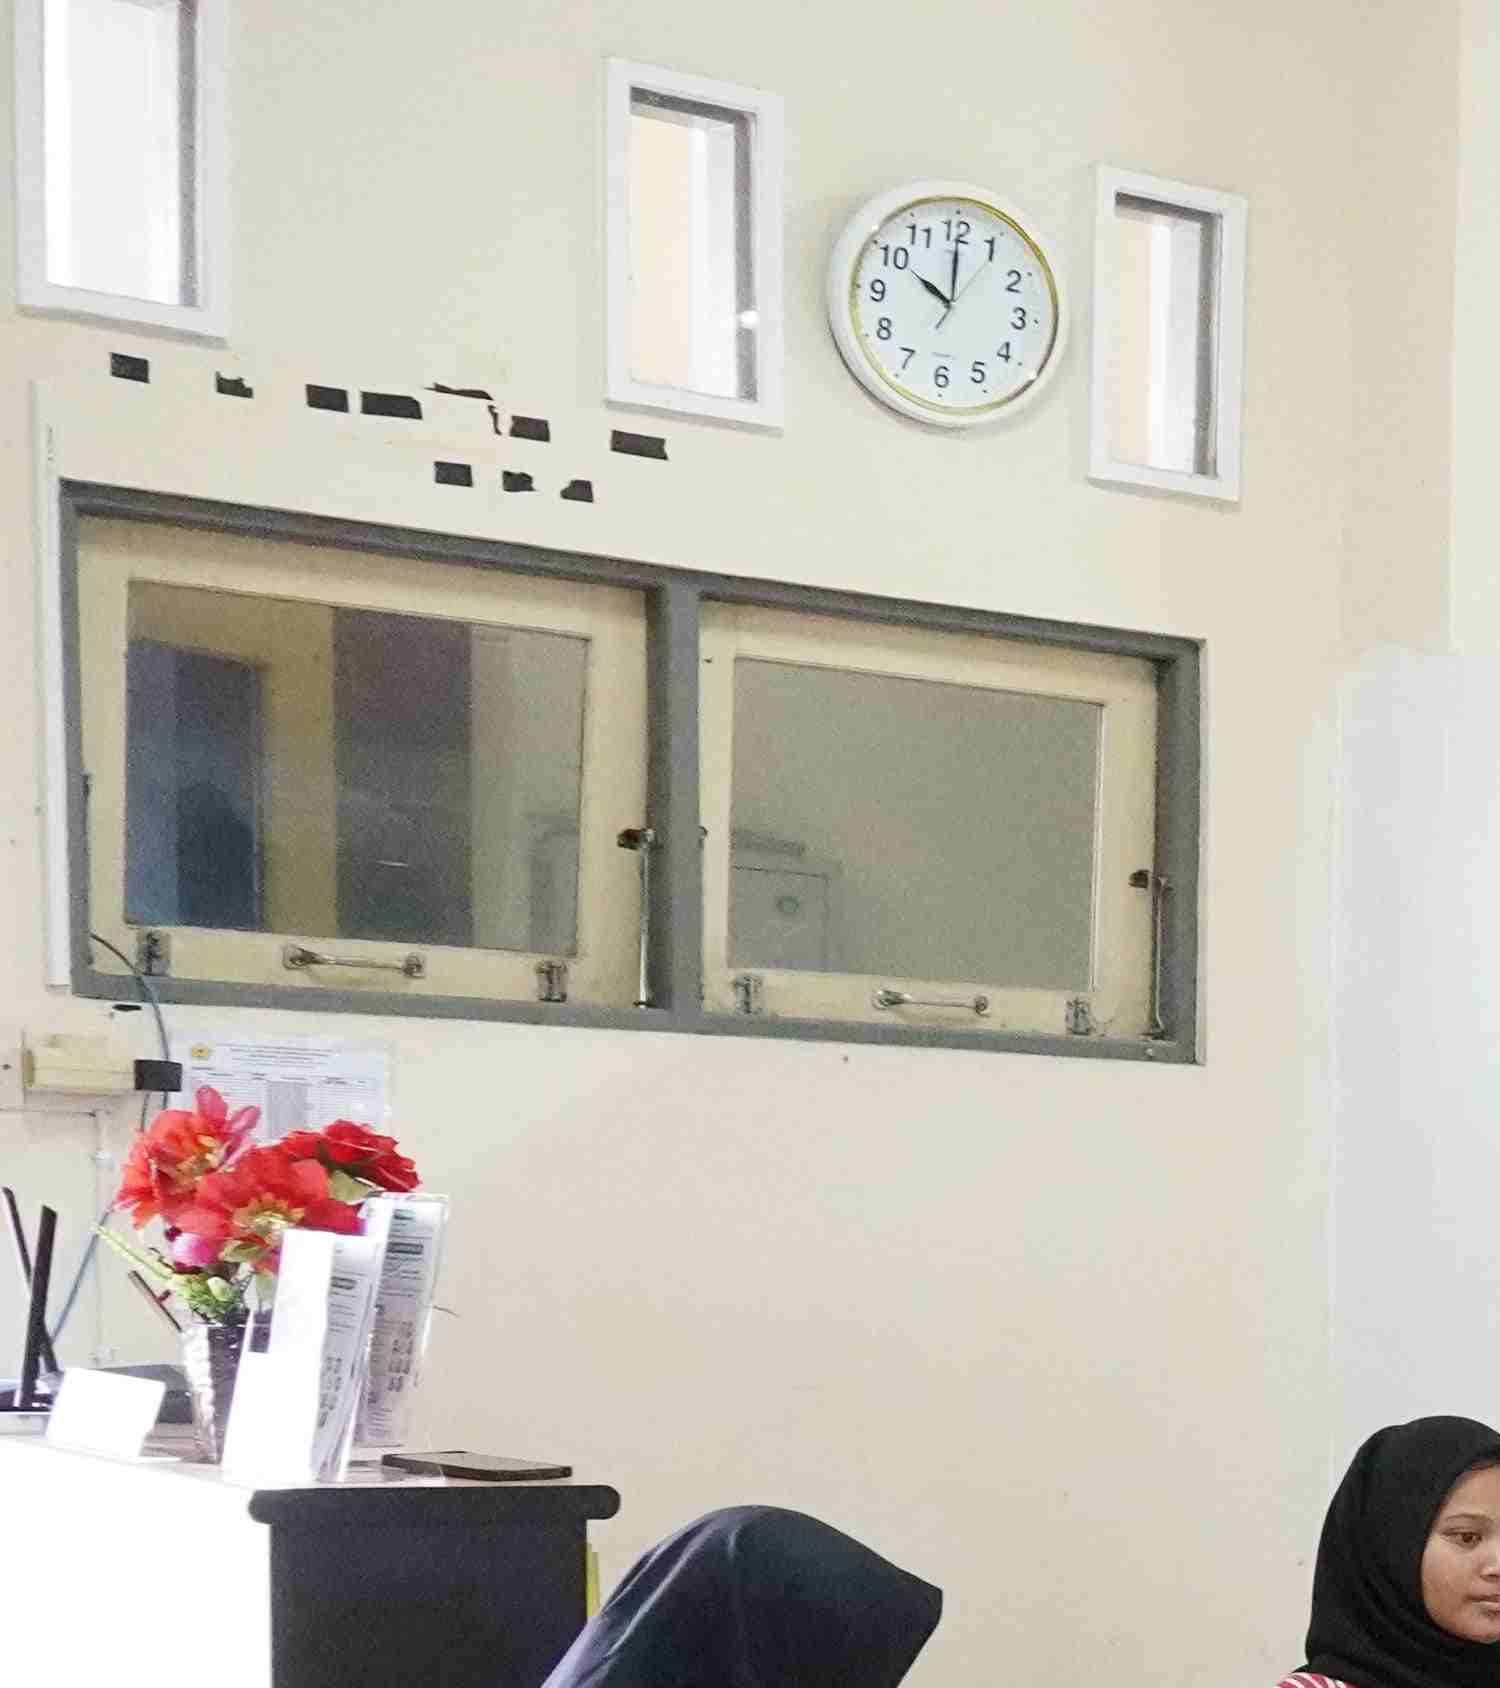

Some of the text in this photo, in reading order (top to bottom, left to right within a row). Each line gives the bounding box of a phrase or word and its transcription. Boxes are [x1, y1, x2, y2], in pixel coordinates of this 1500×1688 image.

[907, 224, 931, 248] 11
[942, 220, 969, 244] 12
[880, 244, 909, 270] 10
[985, 237, 996, 261] 1
[870, 279, 886, 302] 9
[1006, 270, 1021, 293] 2
[876, 318, 892, 340] 8
[1011, 307, 1026, 330] 3
[900, 348, 915, 370] 7
[996, 342, 1011, 362] 4
[934, 367, 949, 387] 6
[971, 361, 986, 383] 5
